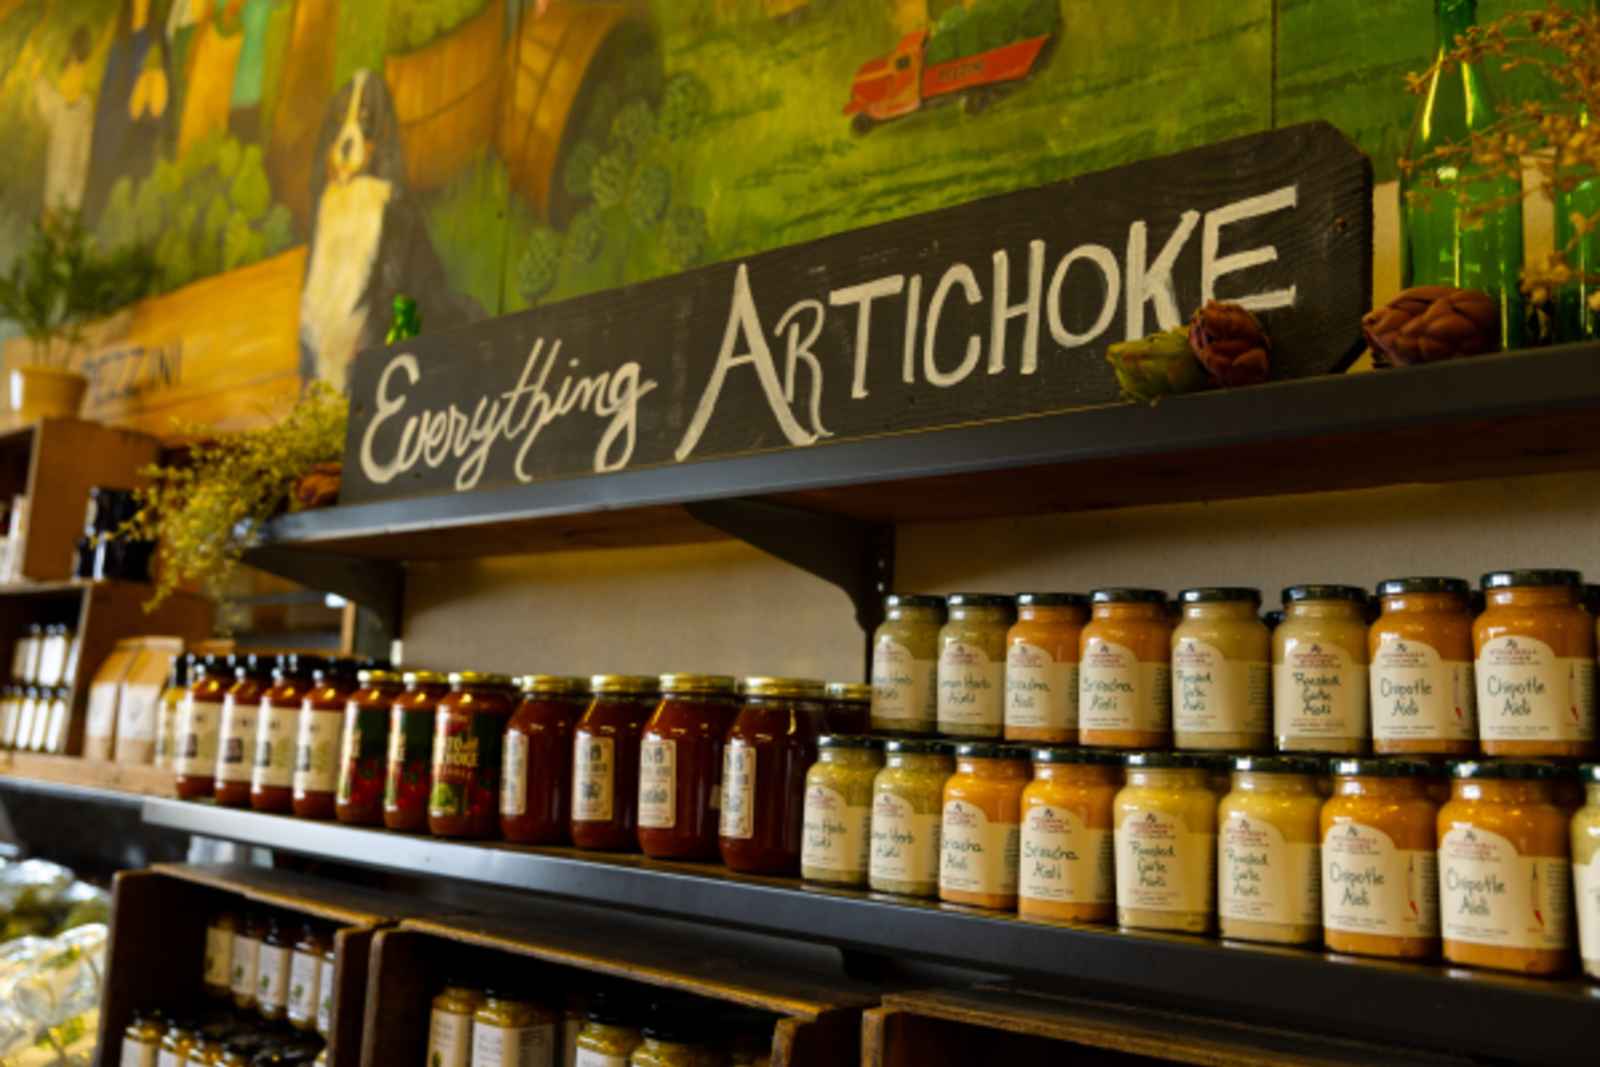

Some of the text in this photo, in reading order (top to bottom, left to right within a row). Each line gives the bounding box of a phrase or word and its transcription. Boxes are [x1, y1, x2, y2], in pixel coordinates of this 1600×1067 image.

[360, 184, 1299, 491] Everything ARTICHOKE
[1487, 675, 1545, 699] Chipotle
